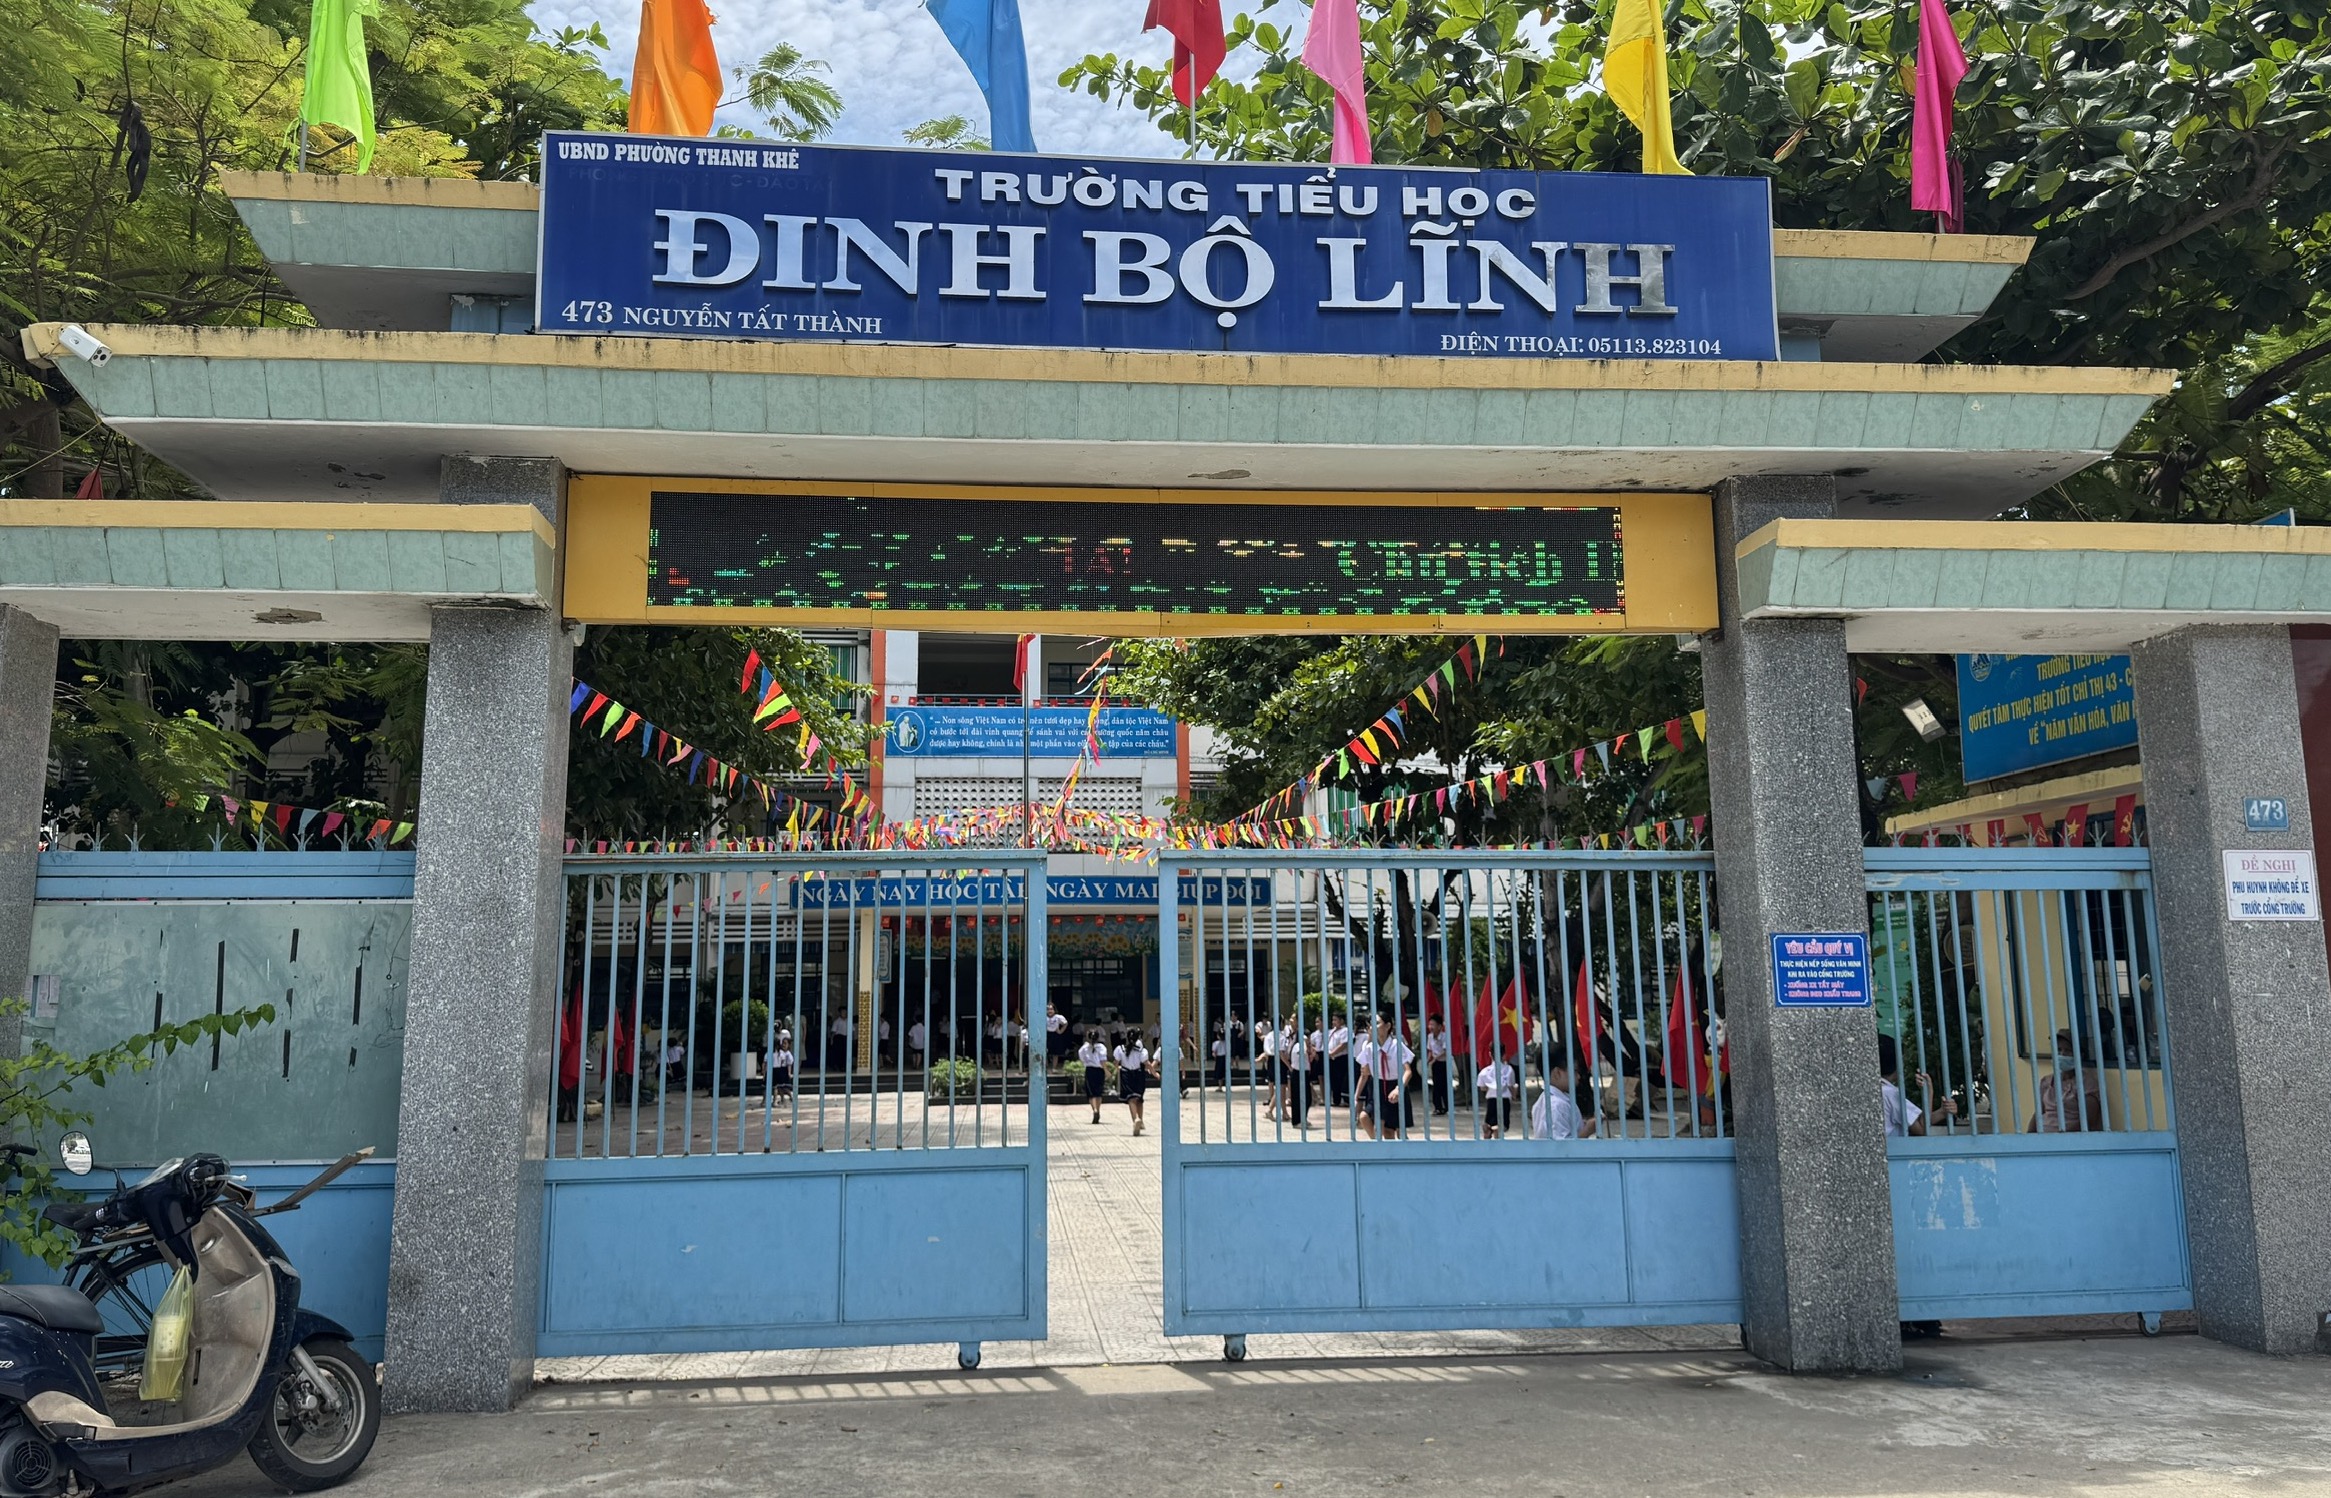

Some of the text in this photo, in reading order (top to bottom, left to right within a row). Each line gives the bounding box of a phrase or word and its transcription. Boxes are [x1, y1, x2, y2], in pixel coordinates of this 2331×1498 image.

[558, 141, 799, 169] UBND PHƯỜNG THANH KHÊ
[935, 167, 1536, 228] TRƯỜNG TIỂU HỌC
[652, 208, 1680, 329] ĐINH BỘ LĨNH
[561, 301, 882, 334] 473 NGUYỄN TẤT THÀNH
[1440, 331, 1721, 356] ĐIỆN THOẠI: 05113.823104
[1968, 705, 1990, 733] QUYẾT
[2011, 696, 2032, 721] THỰC
[2033, 689, 2054, 715] HIỆN
[2055, 681, 2071, 706] TỐT
[2073, 675, 2088, 703] CHỈ
[2089, 675, 2105, 698] THỊ
[2105, 672, 2117, 692] 43
[991, 716, 1007, 725] Nam
[1153, 717, 1169, 725] Nam
[2028, 720, 2039, 745] VỀ
[2068, 712, 2086, 736] VĂN
[2110, 699, 2130, 724] VĂN
[2249, 800, 2284, 821] 473
[2262, 859, 2296, 873] NGHỊ
[872, 884, 921, 901] NAY
[1115, 882, 1160, 898] MAI
